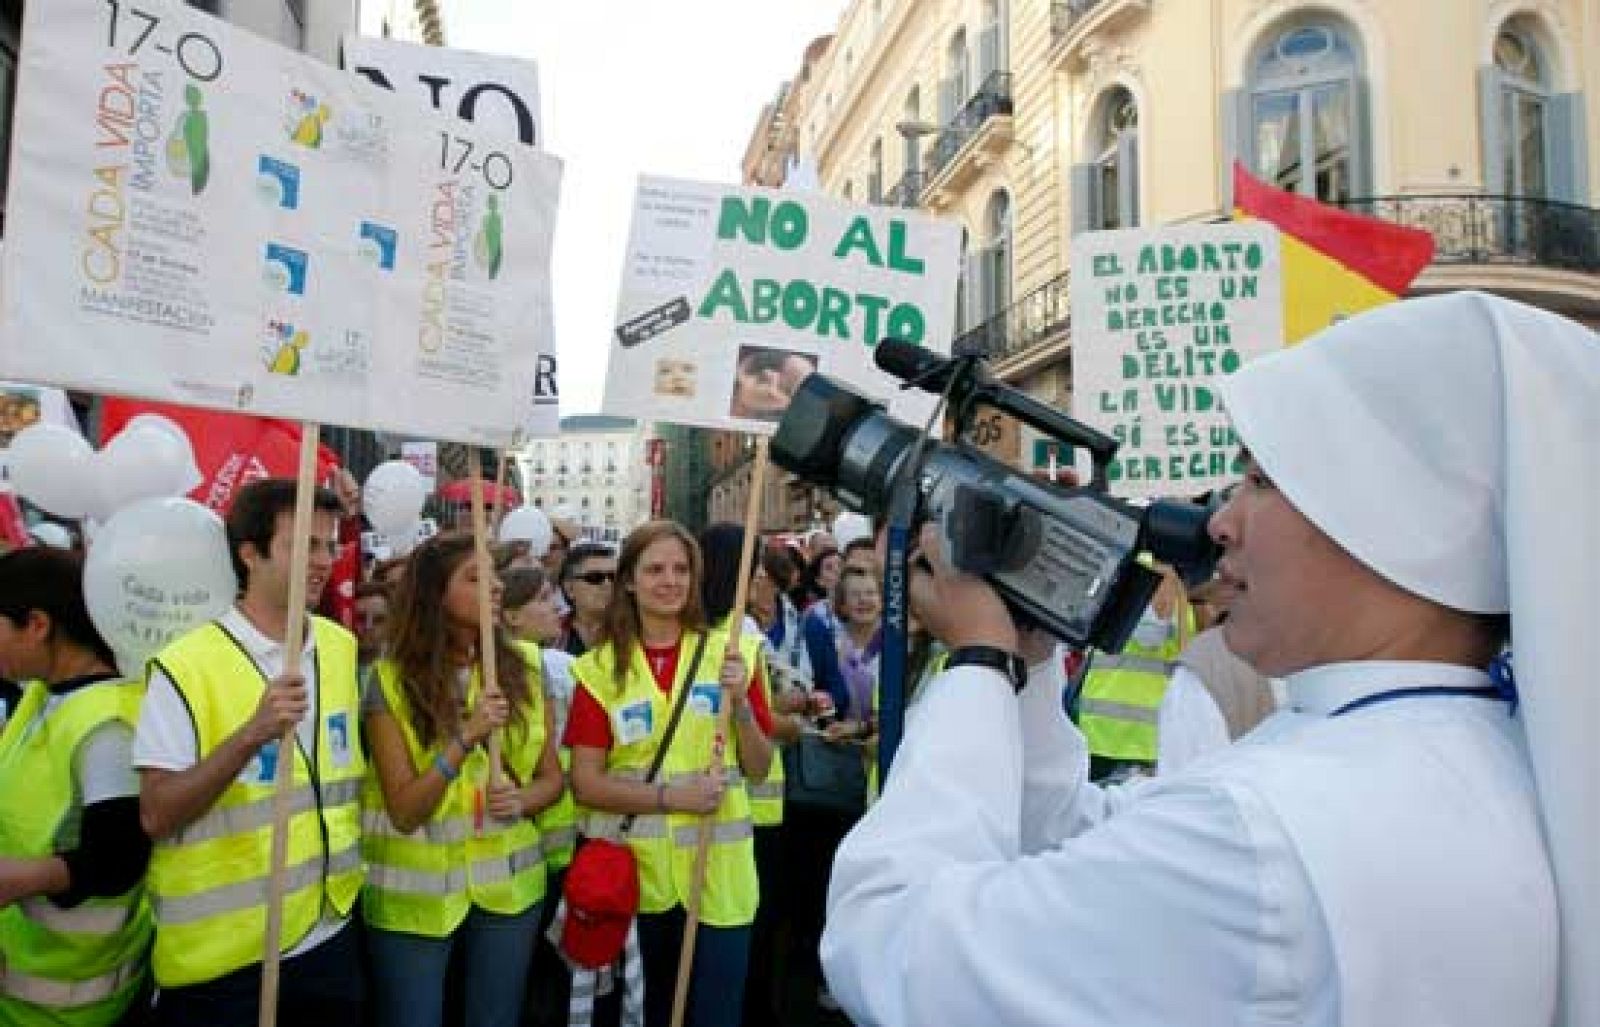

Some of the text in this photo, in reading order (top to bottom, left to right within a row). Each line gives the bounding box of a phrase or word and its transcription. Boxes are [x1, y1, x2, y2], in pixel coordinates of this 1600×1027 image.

[129, 72, 163, 190] IMPORTA
[84, 63, 139, 283] CADA VIDA
[717, 195, 925, 275] NO AL
[1093, 243, 1263, 277] EL ABORTO
[697, 267, 926, 347] ABORTO
[1105, 275, 1258, 305] NO ES UN
[1106, 301, 1226, 332] DERECHO
[1136, 324, 1232, 352] ES UN
[1121, 345, 1241, 379] DELITO
[1100, 389, 1139, 413] LA
[1164, 421, 1200, 447] ES
[887, 549, 903, 629] SONY
